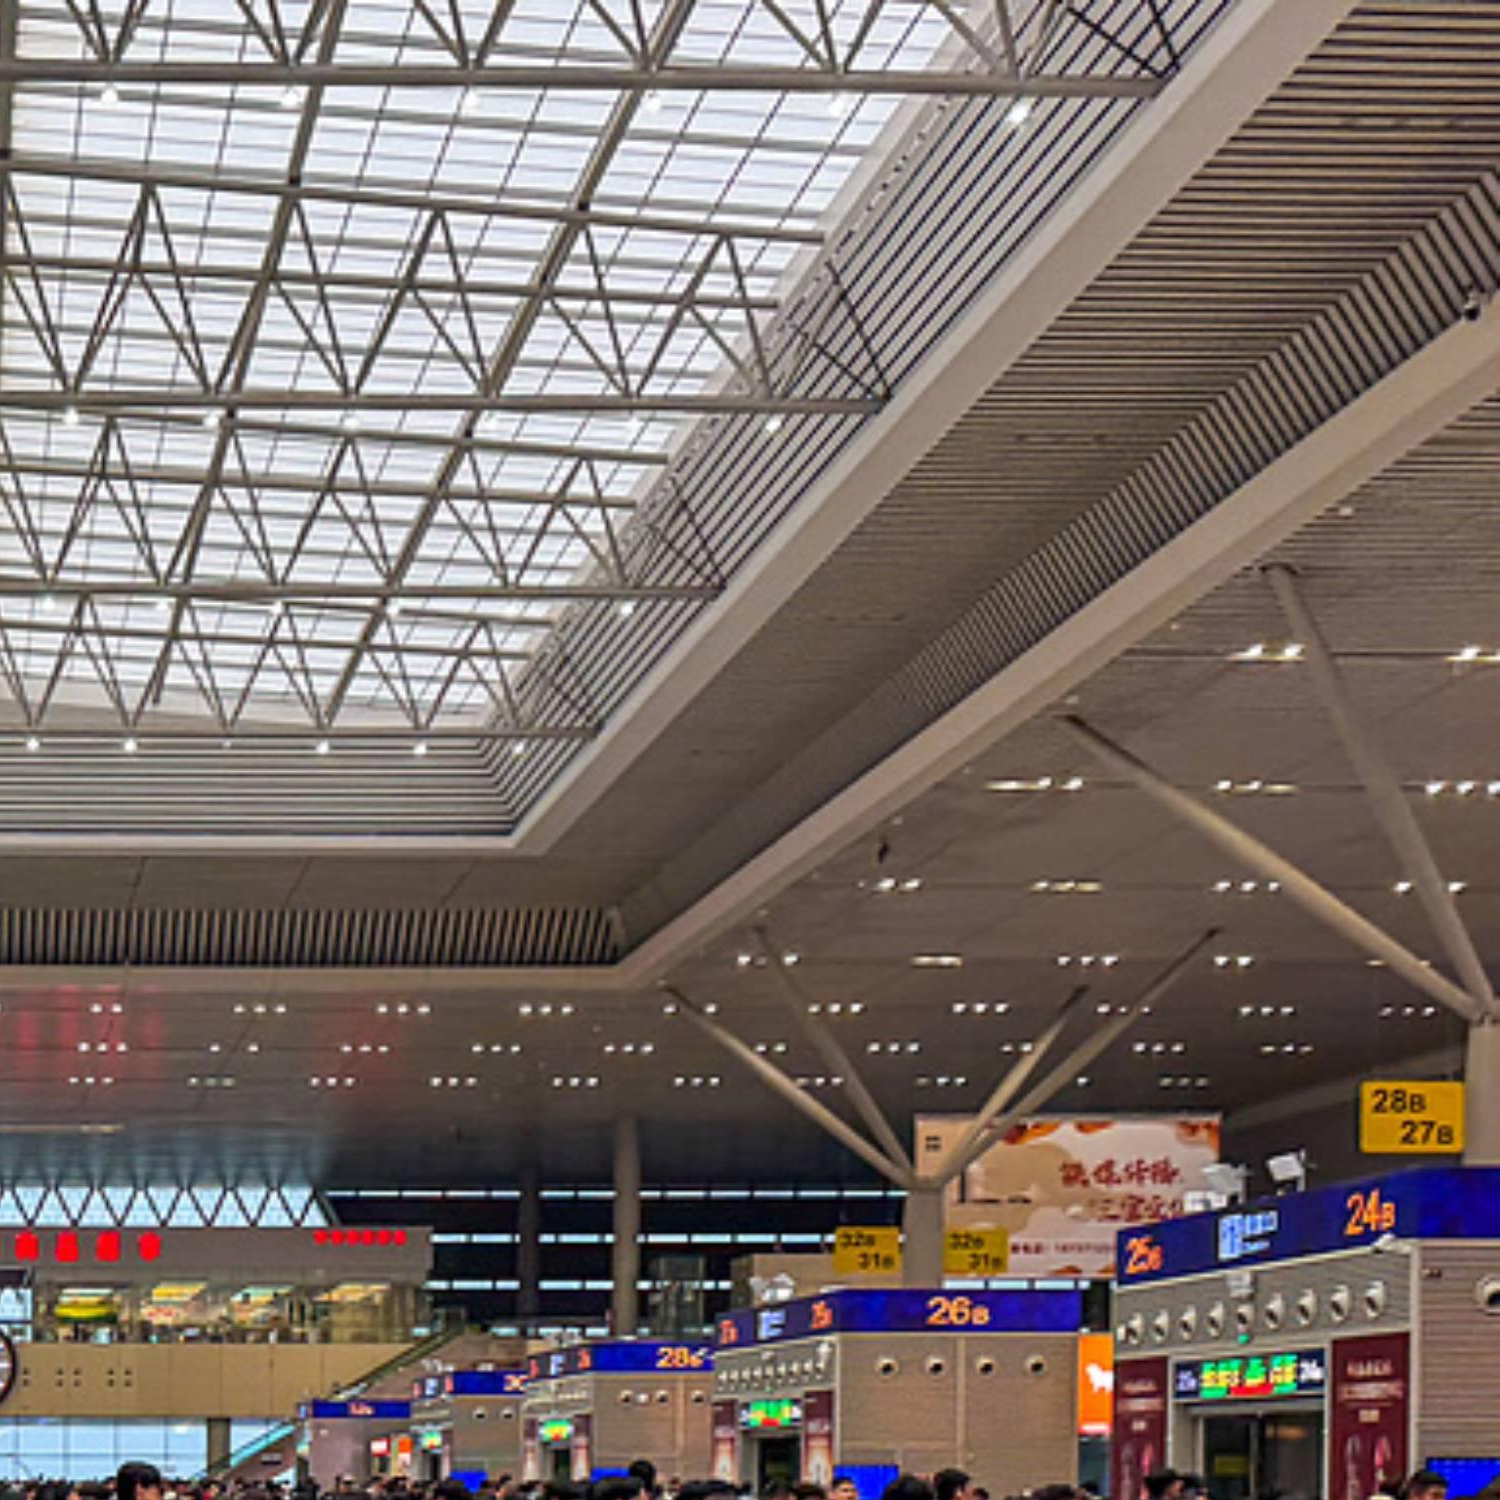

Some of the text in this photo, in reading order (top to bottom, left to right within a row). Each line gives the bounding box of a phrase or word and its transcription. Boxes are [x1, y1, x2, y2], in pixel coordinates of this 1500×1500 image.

[1372, 1089, 1426, 1113] 28B
[1400, 1120, 1454, 1144] 27B
[1344, 1188, 1396, 1236] 24B
[1124, 1236, 1164, 1275] 25B
[926, 1296, 990, 1326] 26B
